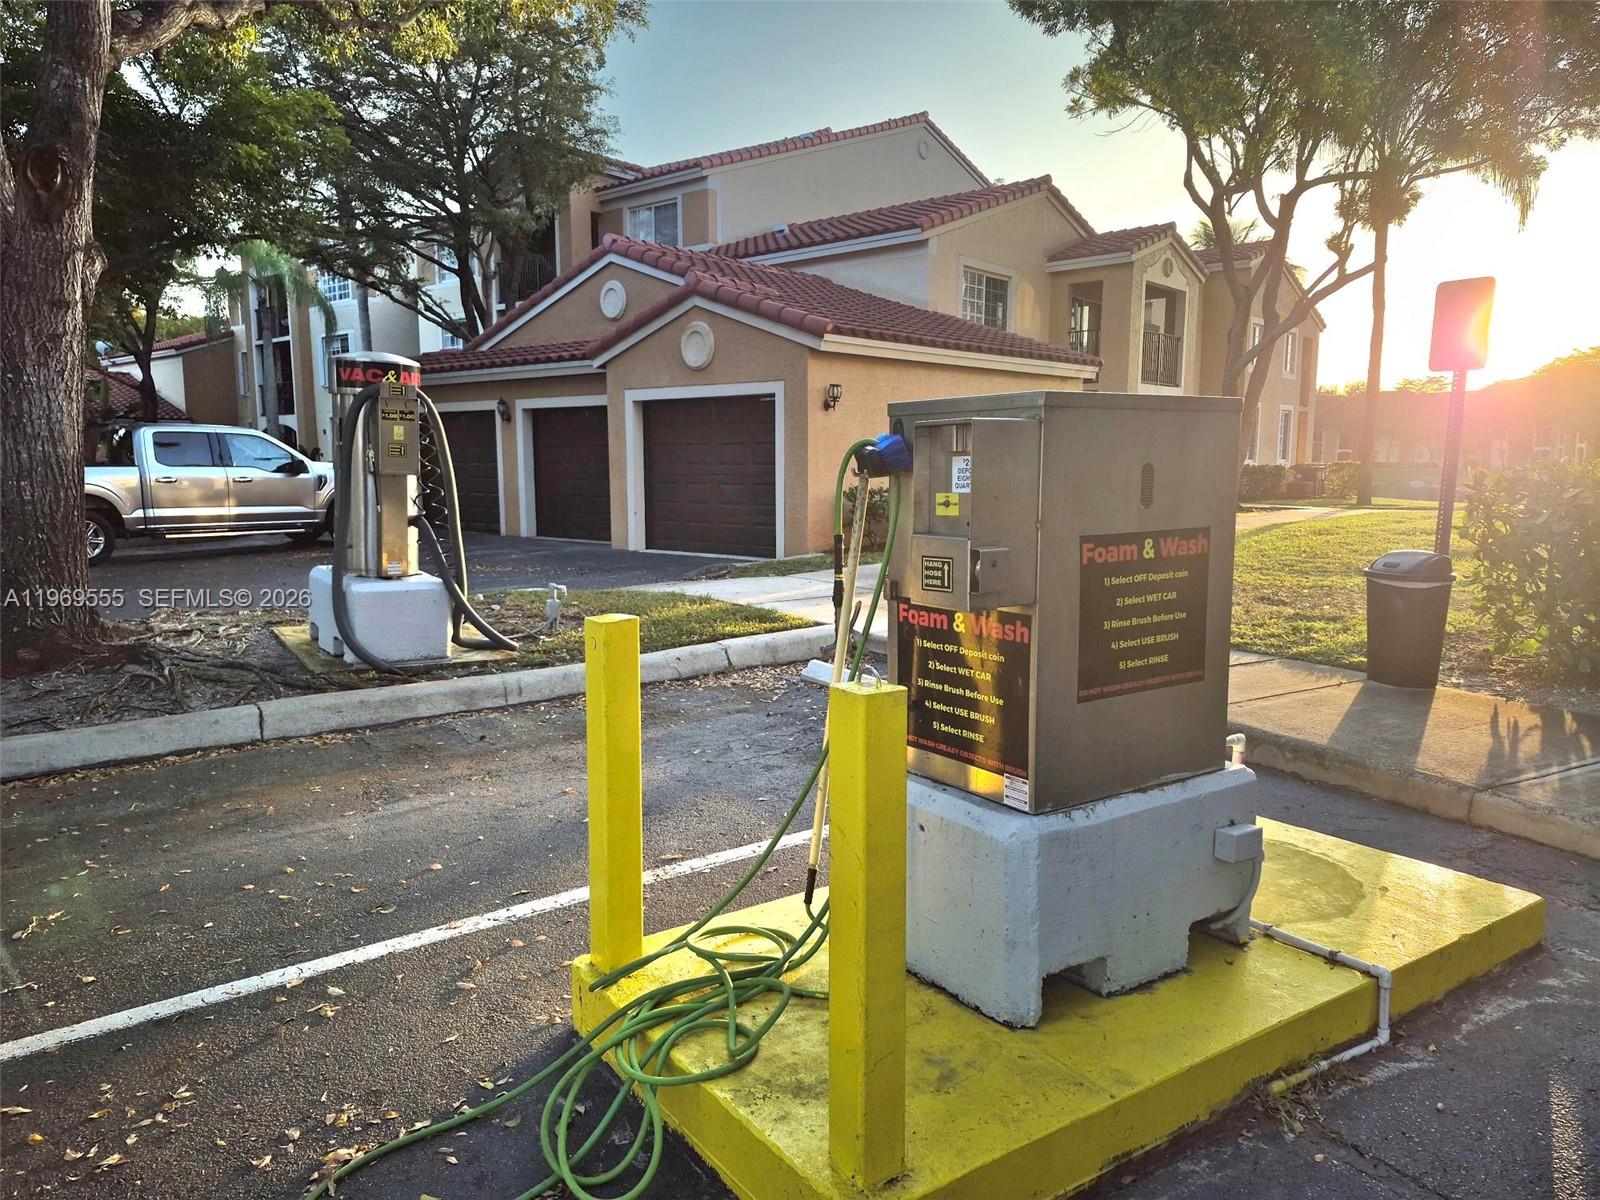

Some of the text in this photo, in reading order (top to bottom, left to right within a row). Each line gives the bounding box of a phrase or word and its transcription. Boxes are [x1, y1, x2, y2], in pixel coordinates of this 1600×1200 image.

[339, 367, 384, 384] VAC
[382, 370, 397, 382] &
[1082, 534, 1208, 565] Foam & Wash
[1104, 570, 1188, 587] 1) Select OFF Deposit coin
[1116, 592, 1177, 606] 2) Select WET CAR
[899, 603, 1030, 644] Foam & Wash
[1104, 621, 1110, 630] 3)
[1112, 619, 1131, 628] Rinse
[1132, 616, 1151, 626] Brush
[1153, 613, 1174, 622] Before
[917, 639, 1005, 662] 1) Select OFF Deposit coin
[1111, 632, 1179, 650] 4) Select USE BRUSH
[928, 661, 992, 681] 2) Select WET CAR
[1119, 654, 1168, 670] 5) Select RINSE
[918, 678, 1004, 705] 3) Rinse Brush Before Use
[925, 700, 995, 725] 4) Select USE BRUSH
[933, 722, 984, 743] 5) Select RINSE
